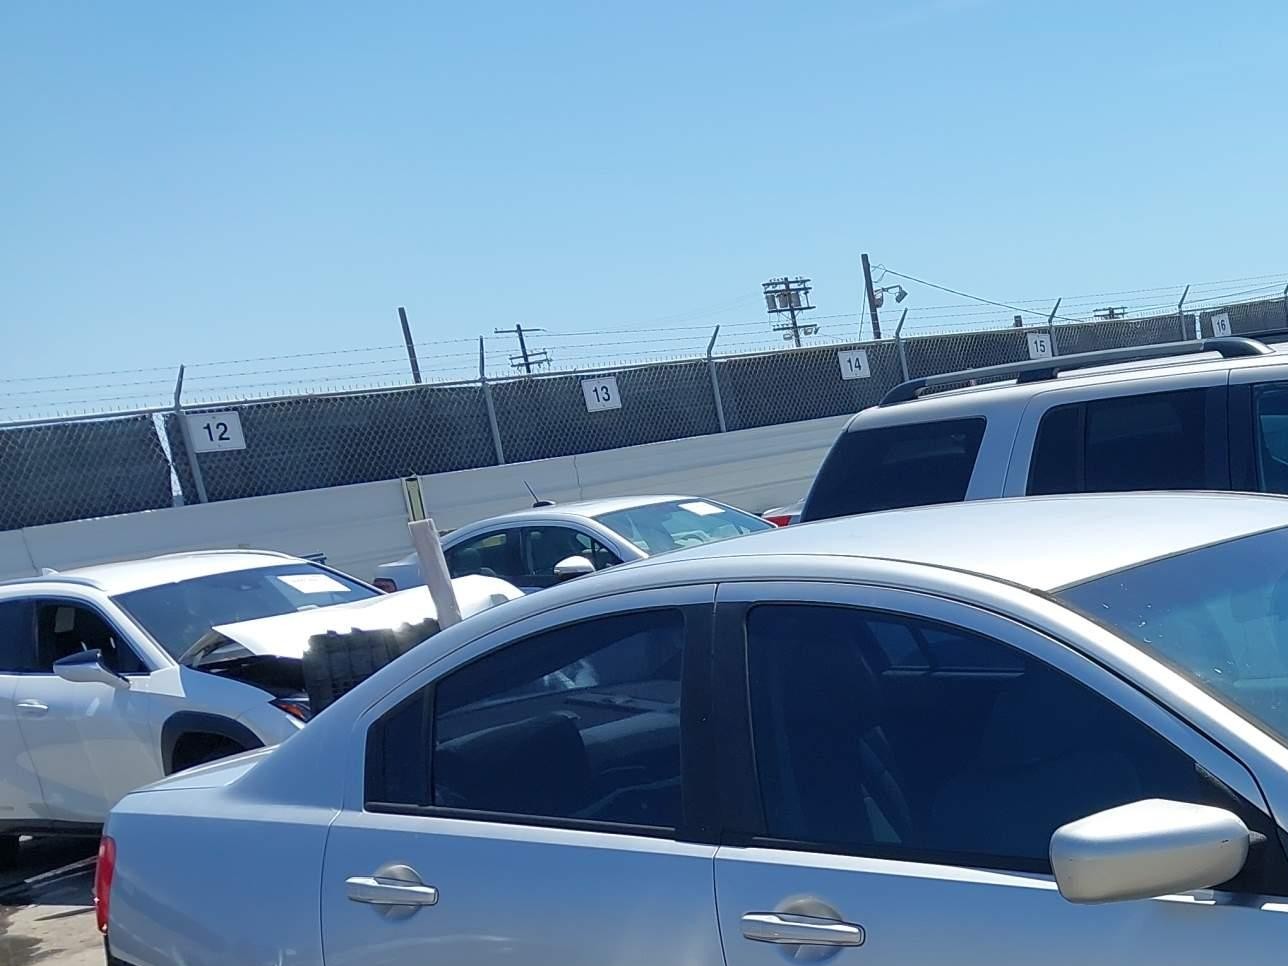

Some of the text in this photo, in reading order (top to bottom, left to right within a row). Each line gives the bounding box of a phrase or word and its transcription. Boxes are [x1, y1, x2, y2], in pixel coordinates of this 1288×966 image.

[1216, 319, 1226, 333] 16
[1034, 340, 1046, 353] 15
[847, 357, 862, 372] 14
[592, 385, 611, 402] 13
[203, 422, 231, 441] 12
